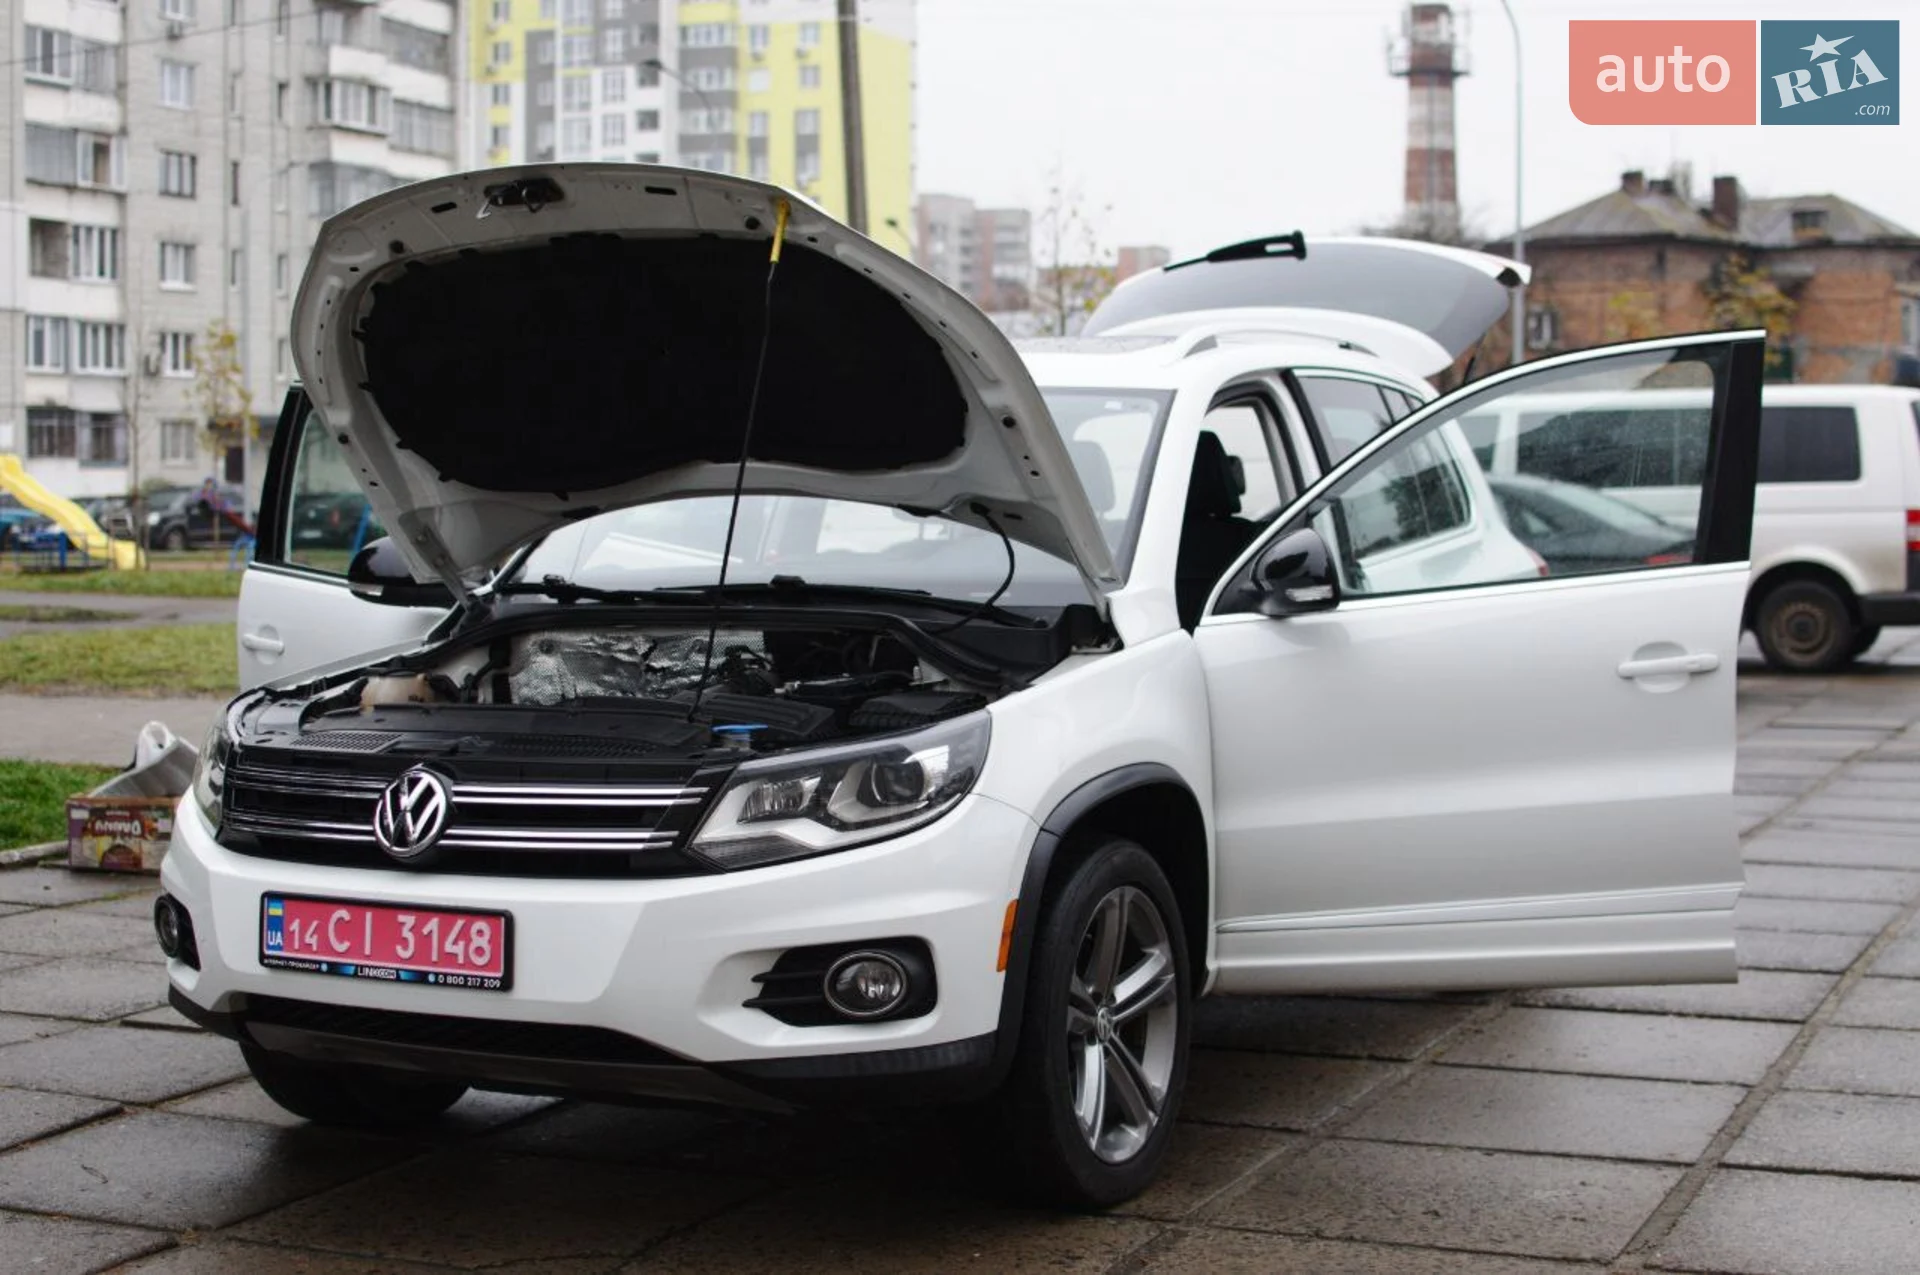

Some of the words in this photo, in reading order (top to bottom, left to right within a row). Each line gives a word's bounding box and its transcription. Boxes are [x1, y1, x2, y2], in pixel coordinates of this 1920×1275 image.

[267, 930, 283, 946] UA
[395, 914, 492, 967] 3148
[446, 975, 465, 985] 800
[467, 977, 481, 987] 217
[483, 978, 500, 989] 209
